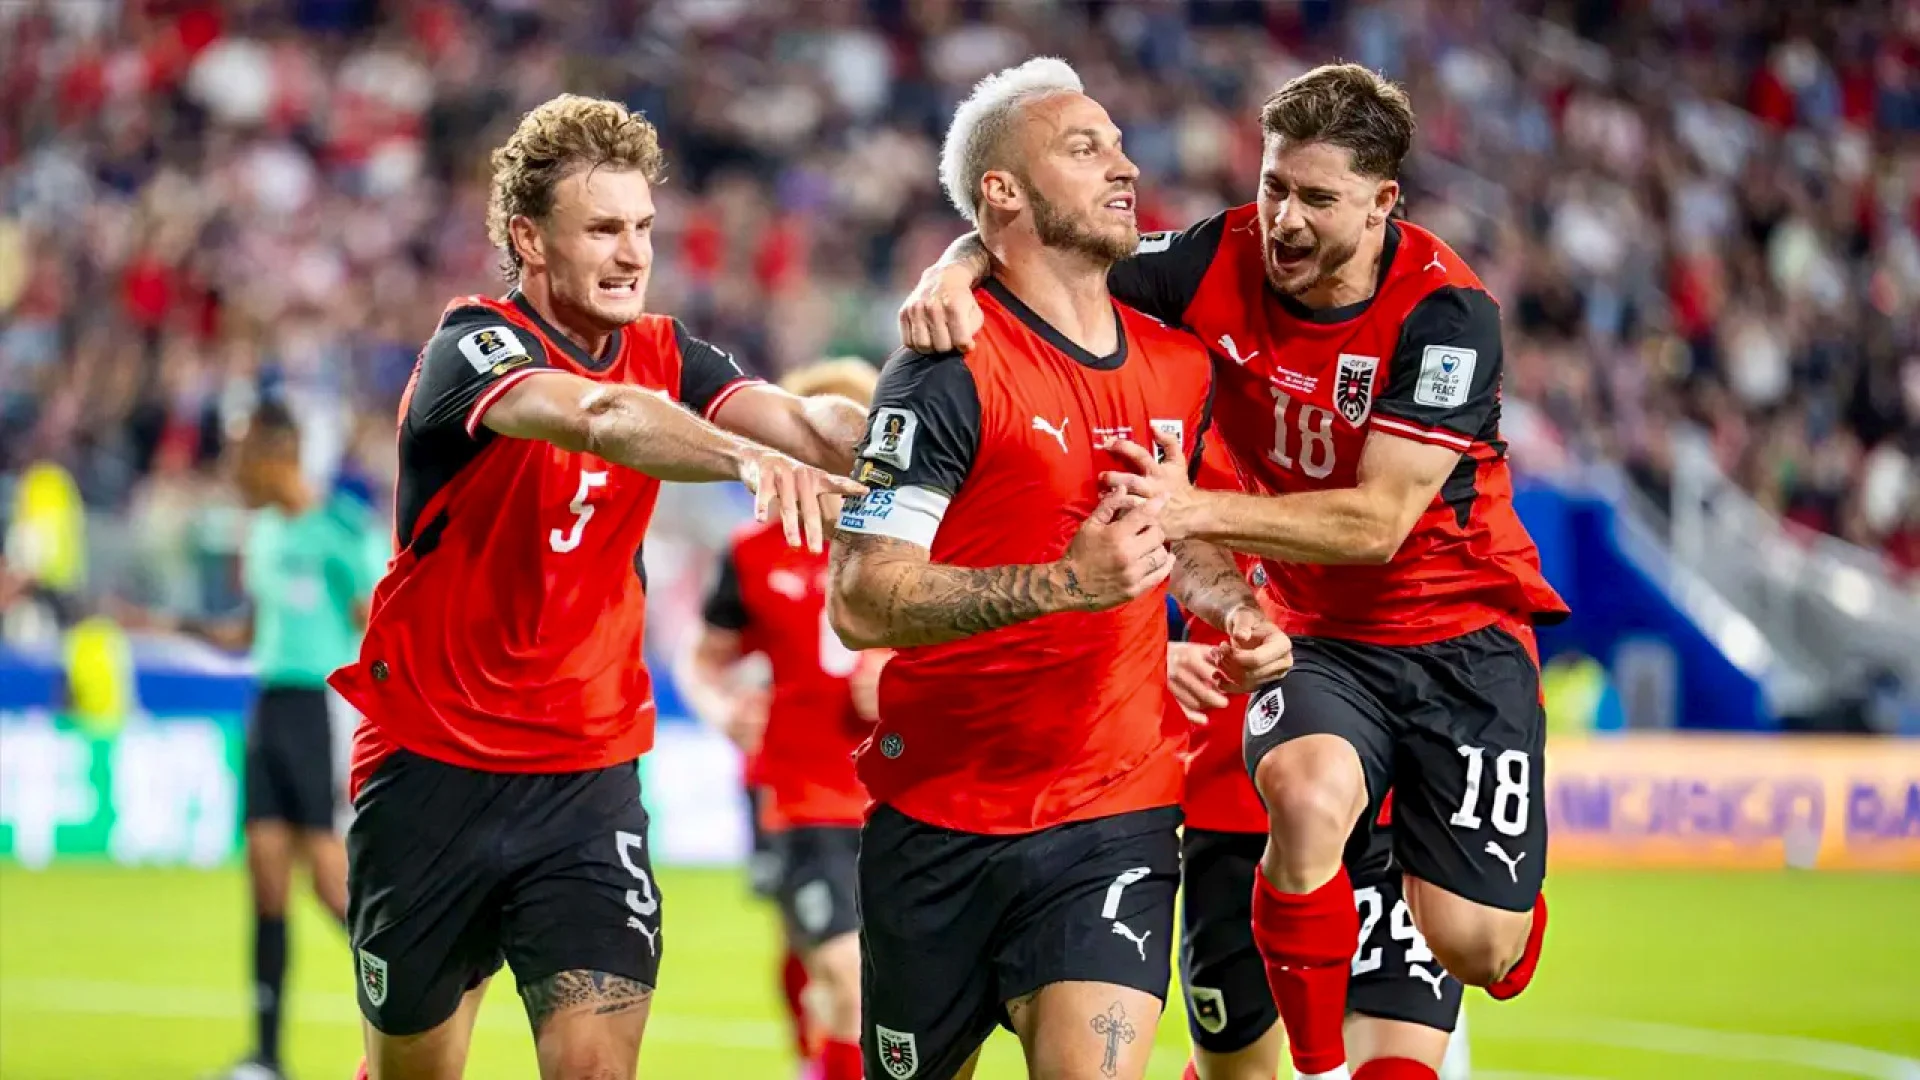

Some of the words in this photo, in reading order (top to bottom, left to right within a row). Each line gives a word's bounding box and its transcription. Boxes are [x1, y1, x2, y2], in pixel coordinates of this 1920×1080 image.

[1267, 386, 1336, 479] 18
[1431, 382, 1457, 397] PEACE
[548, 467, 609, 554] 5
[1450, 744, 1530, 836] 18
[615, 830, 658, 916] 5
[1101, 866, 1152, 919] 7
[1351, 886, 1435, 977] 24
